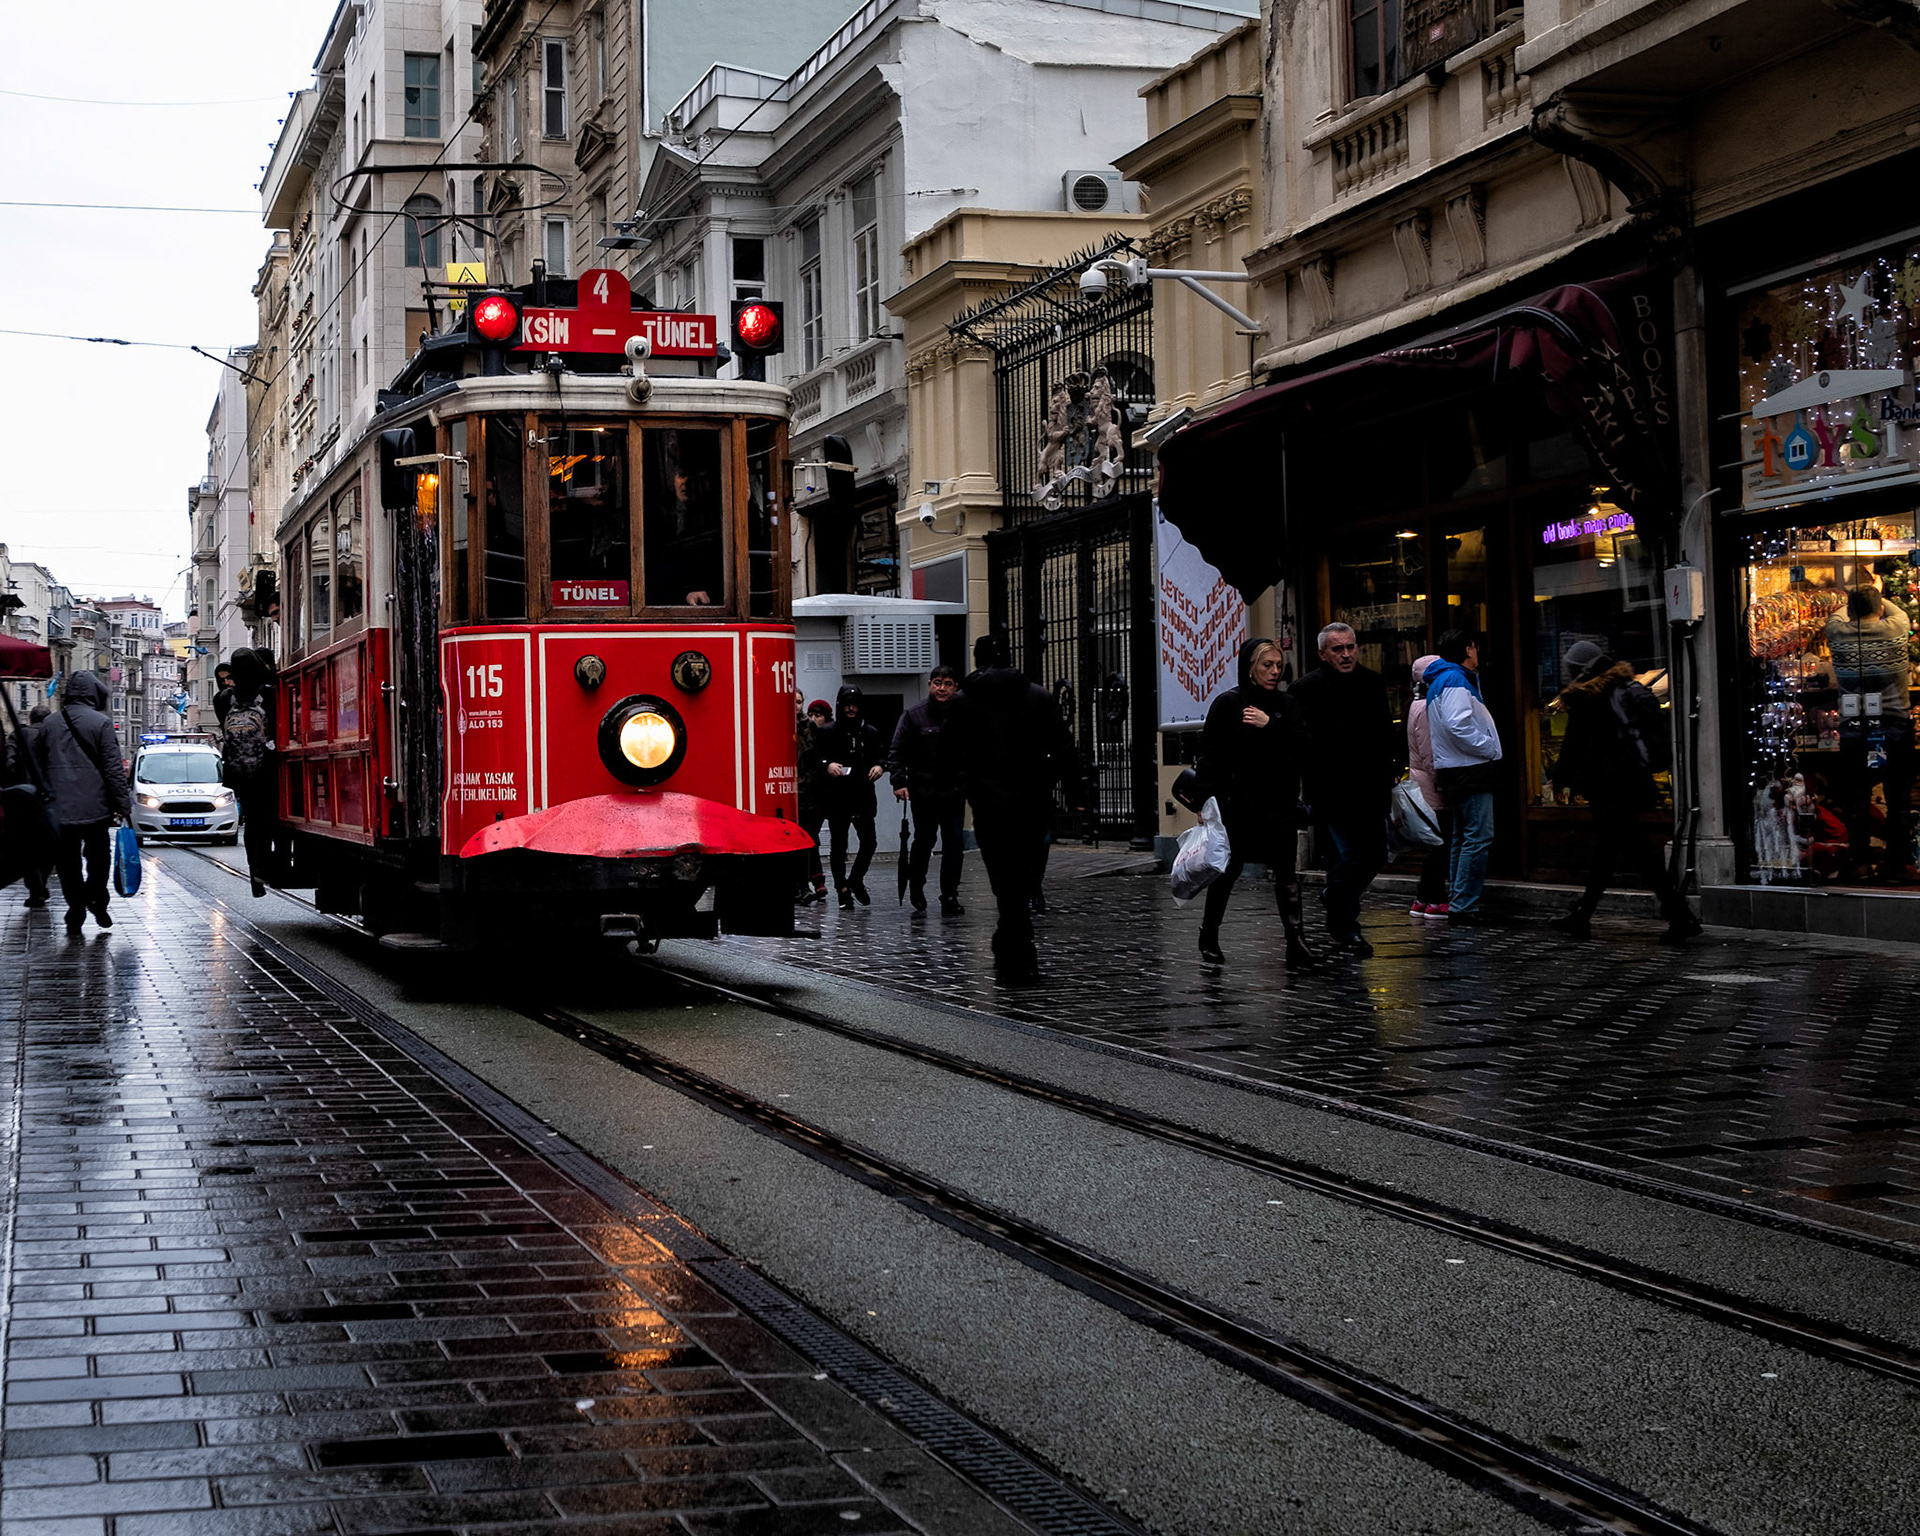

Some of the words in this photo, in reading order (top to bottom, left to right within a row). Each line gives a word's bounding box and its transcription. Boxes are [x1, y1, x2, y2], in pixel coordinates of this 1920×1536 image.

[593, 273, 609, 304] 4
[643, 316, 713, 349] TÜNEL
[1632, 294, 1672, 426] BOOKS
[1542, 522, 1556, 544] old
[1556, 518, 1583, 541] books
[560, 585, 619, 600] TÜNEL
[466, 664, 503, 698] 115
[771, 661, 794, 693] 115
[468, 720, 485, 729] ALO
[487, 719, 503, 728] 153
[484, 772, 514, 785] YASAK
[764, 782, 776, 795] VE
